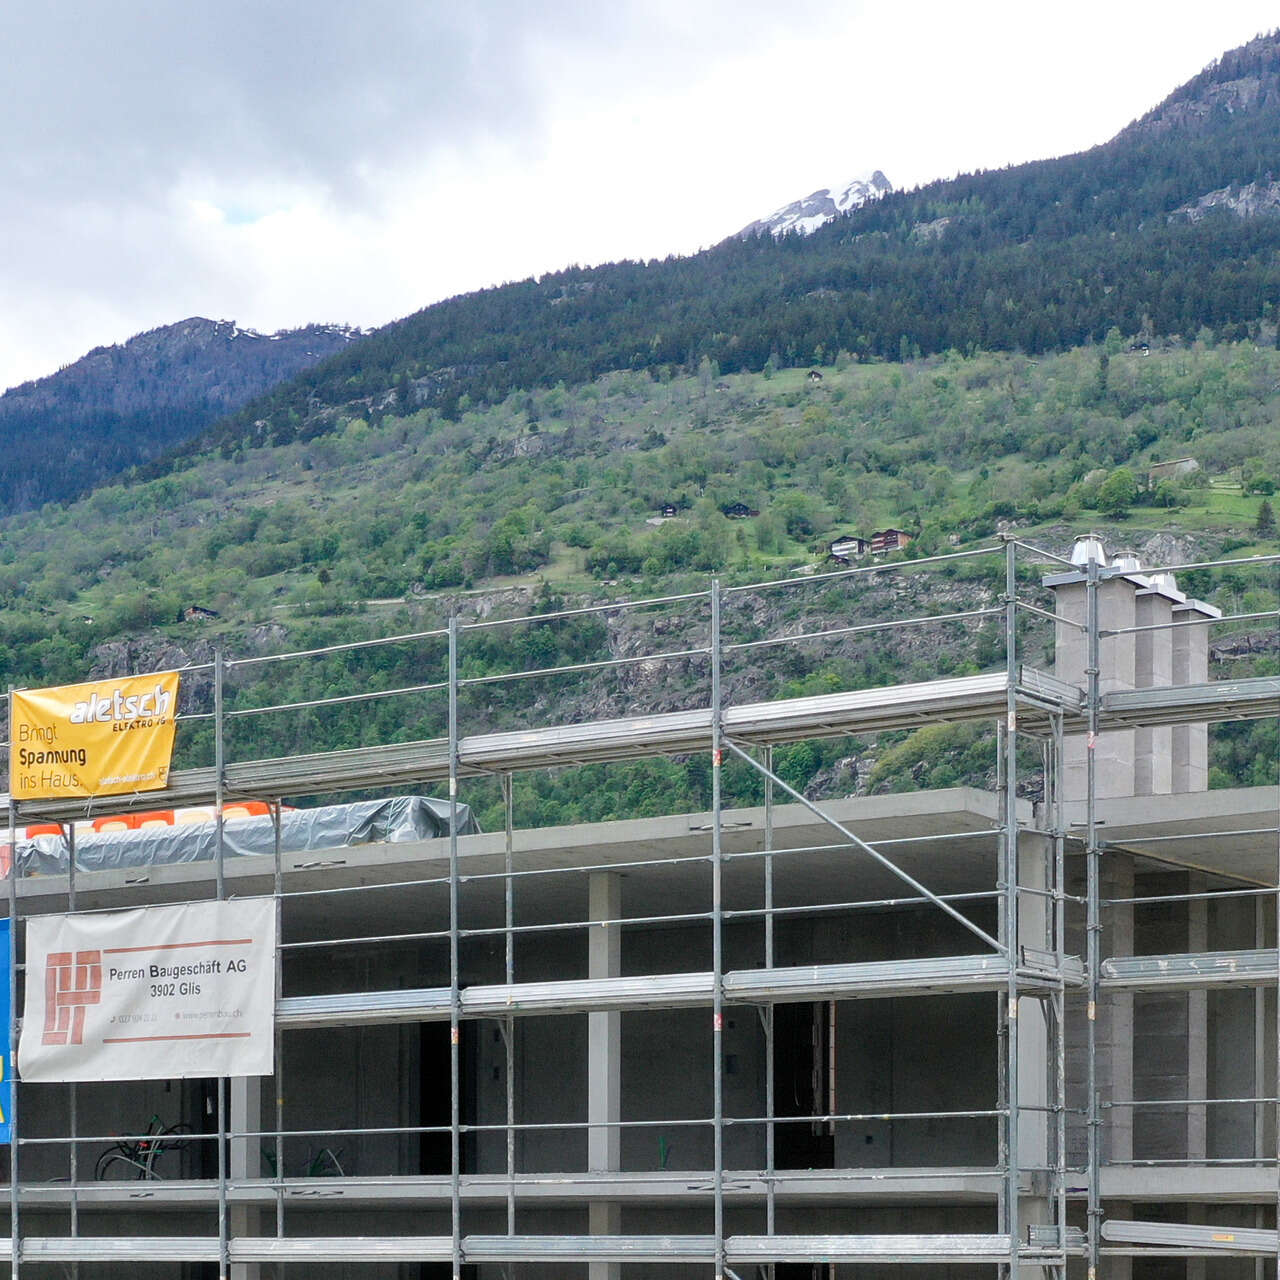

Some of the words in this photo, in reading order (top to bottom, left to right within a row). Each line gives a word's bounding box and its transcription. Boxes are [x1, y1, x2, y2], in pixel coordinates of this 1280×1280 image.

[70, 684, 171, 724] aletsch
[19, 748, 86, 768] Spannung
[20, 772, 36, 790] ins
[41, 770, 84, 788] Haus.
[109, 967, 145, 981] Perren
[150, 960, 221, 980] Baugeschäft
[226, 959, 247, 973] AG
[150, 983, 175, 998] 3902
[179, 982, 201, 996] Glis
